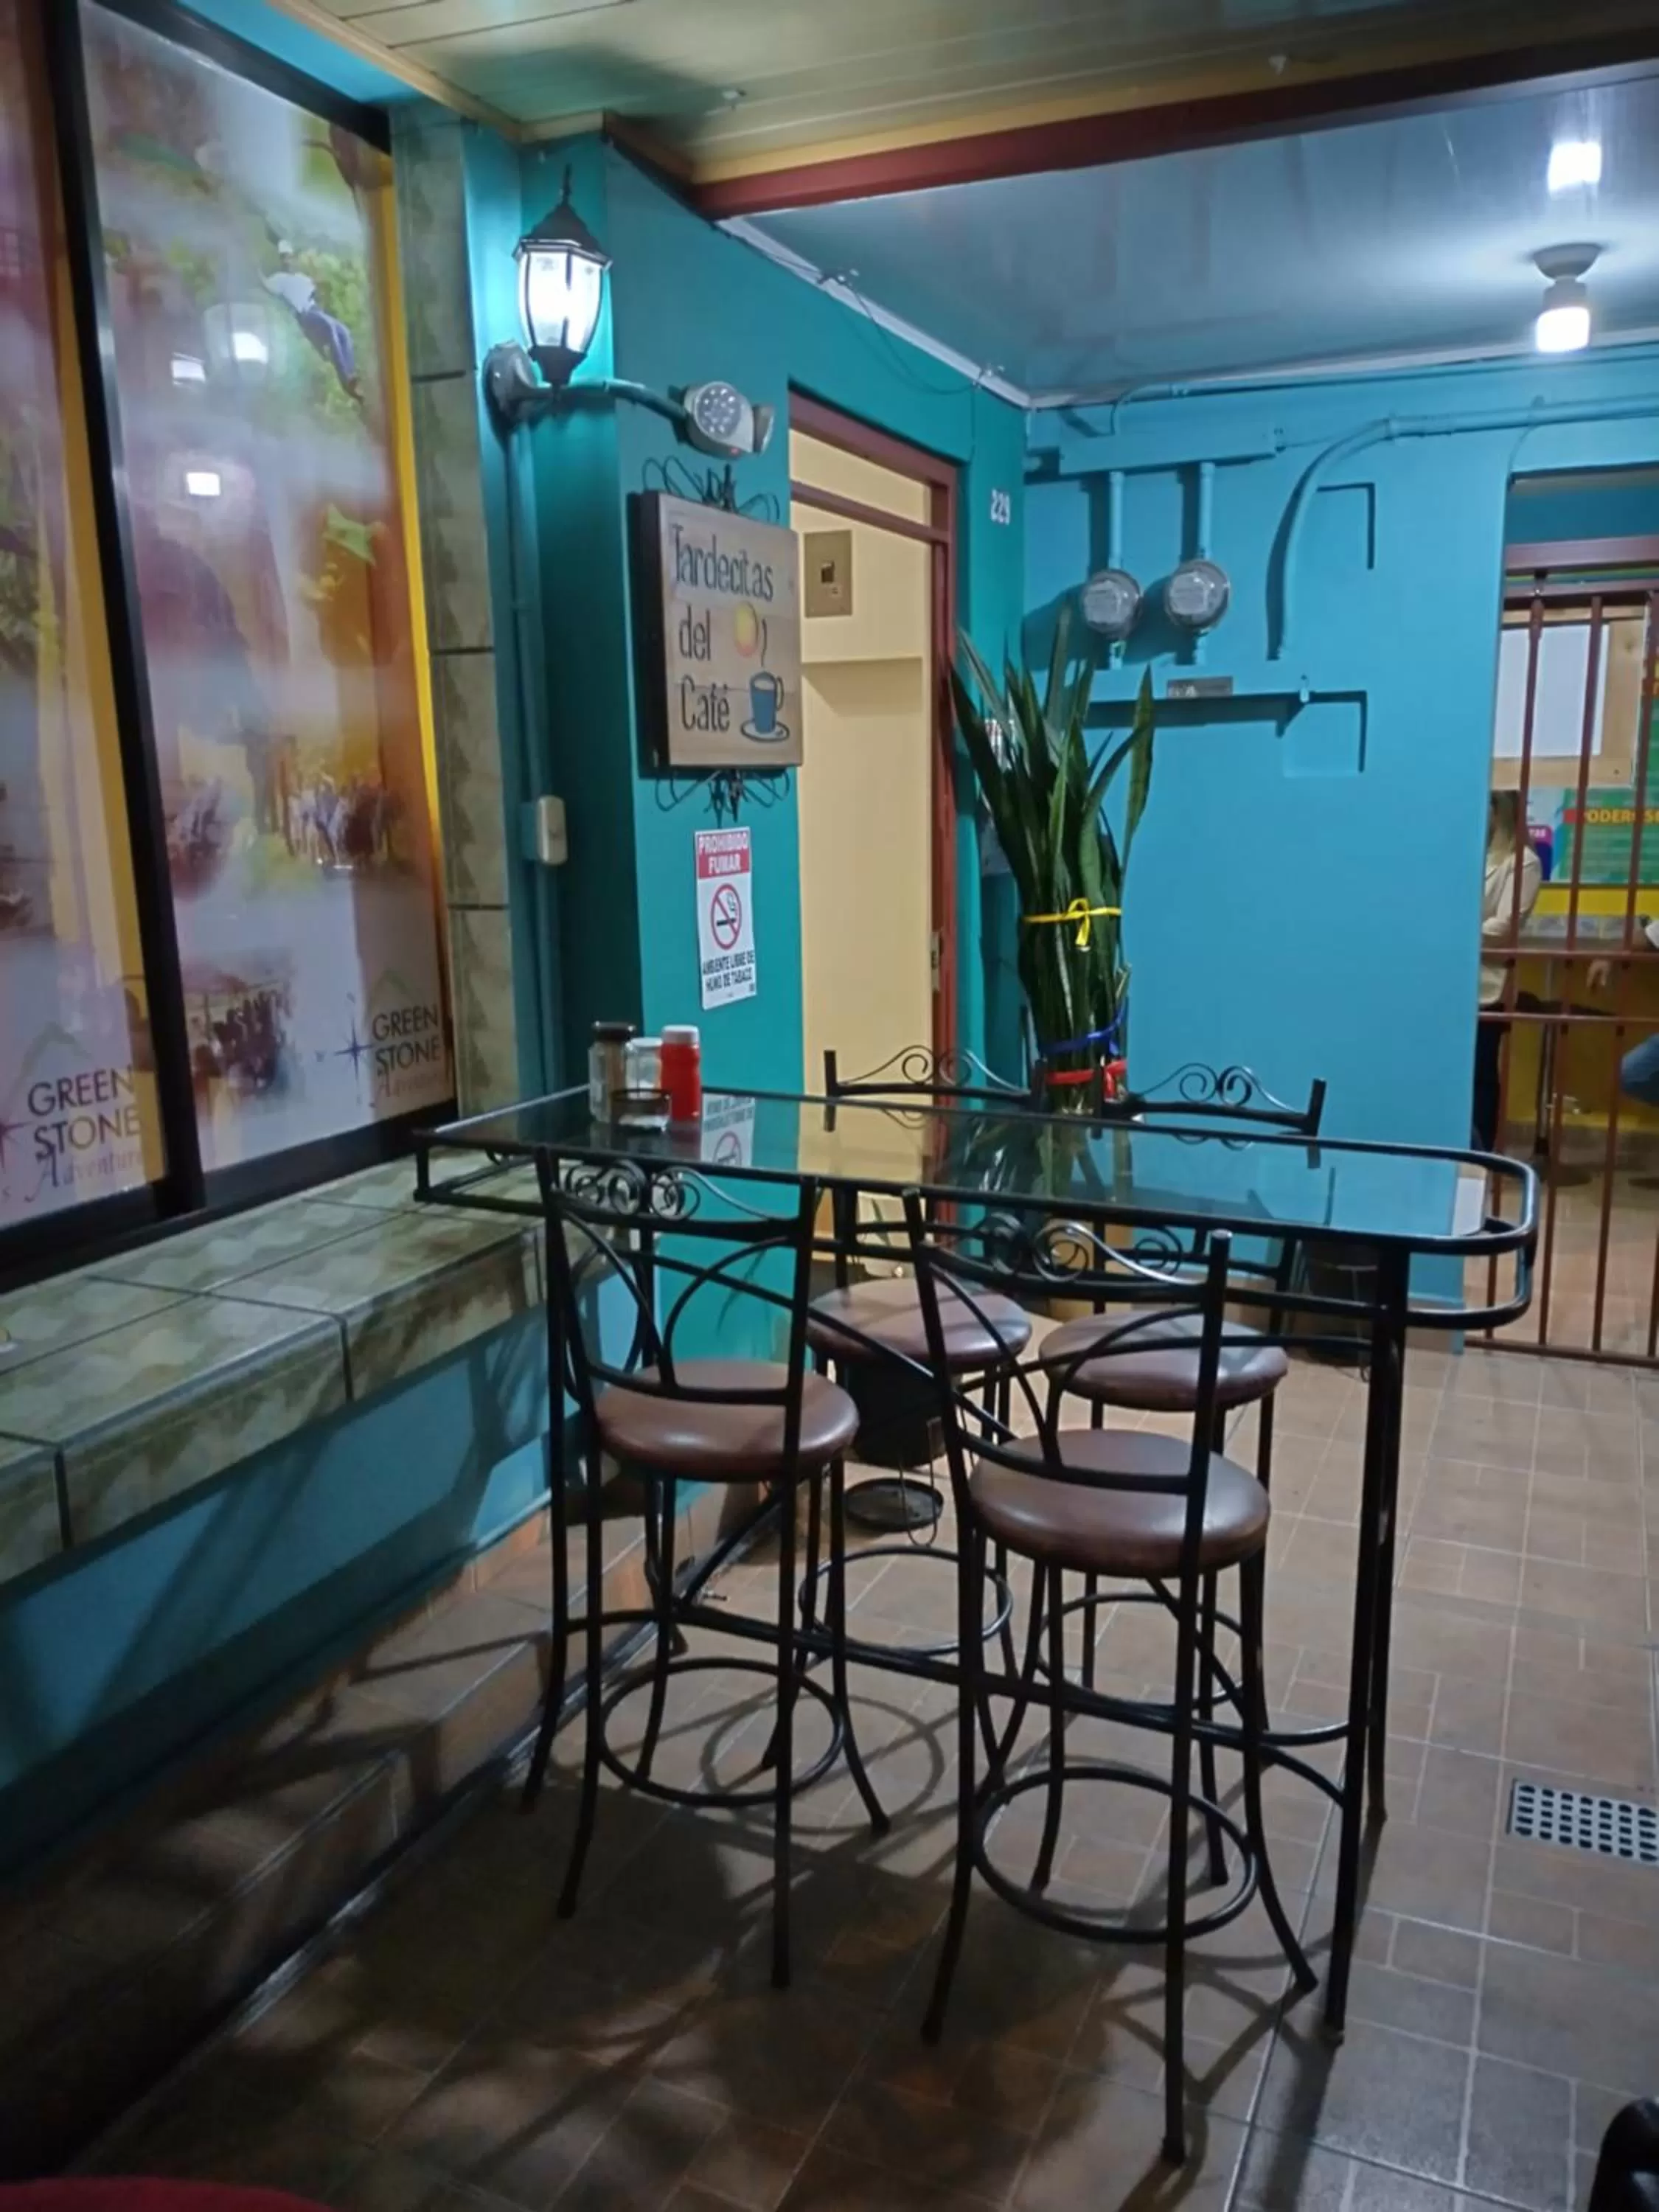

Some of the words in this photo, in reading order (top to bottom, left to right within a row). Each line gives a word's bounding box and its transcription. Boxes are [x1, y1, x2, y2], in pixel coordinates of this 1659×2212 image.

[672, 523, 773, 602] Tardecitas
[678, 605, 712, 662] del
[681, 674, 730, 732] Café
[699, 832, 748, 855] PROHIBIDO
[709, 853, 740, 875] FUMAR
[372, 1004, 439, 1041] GREEN
[375, 1034, 441, 1077] STONE
[27, 1064, 136, 1116] GREEN
[33, 1105, 142, 1163] STONE
